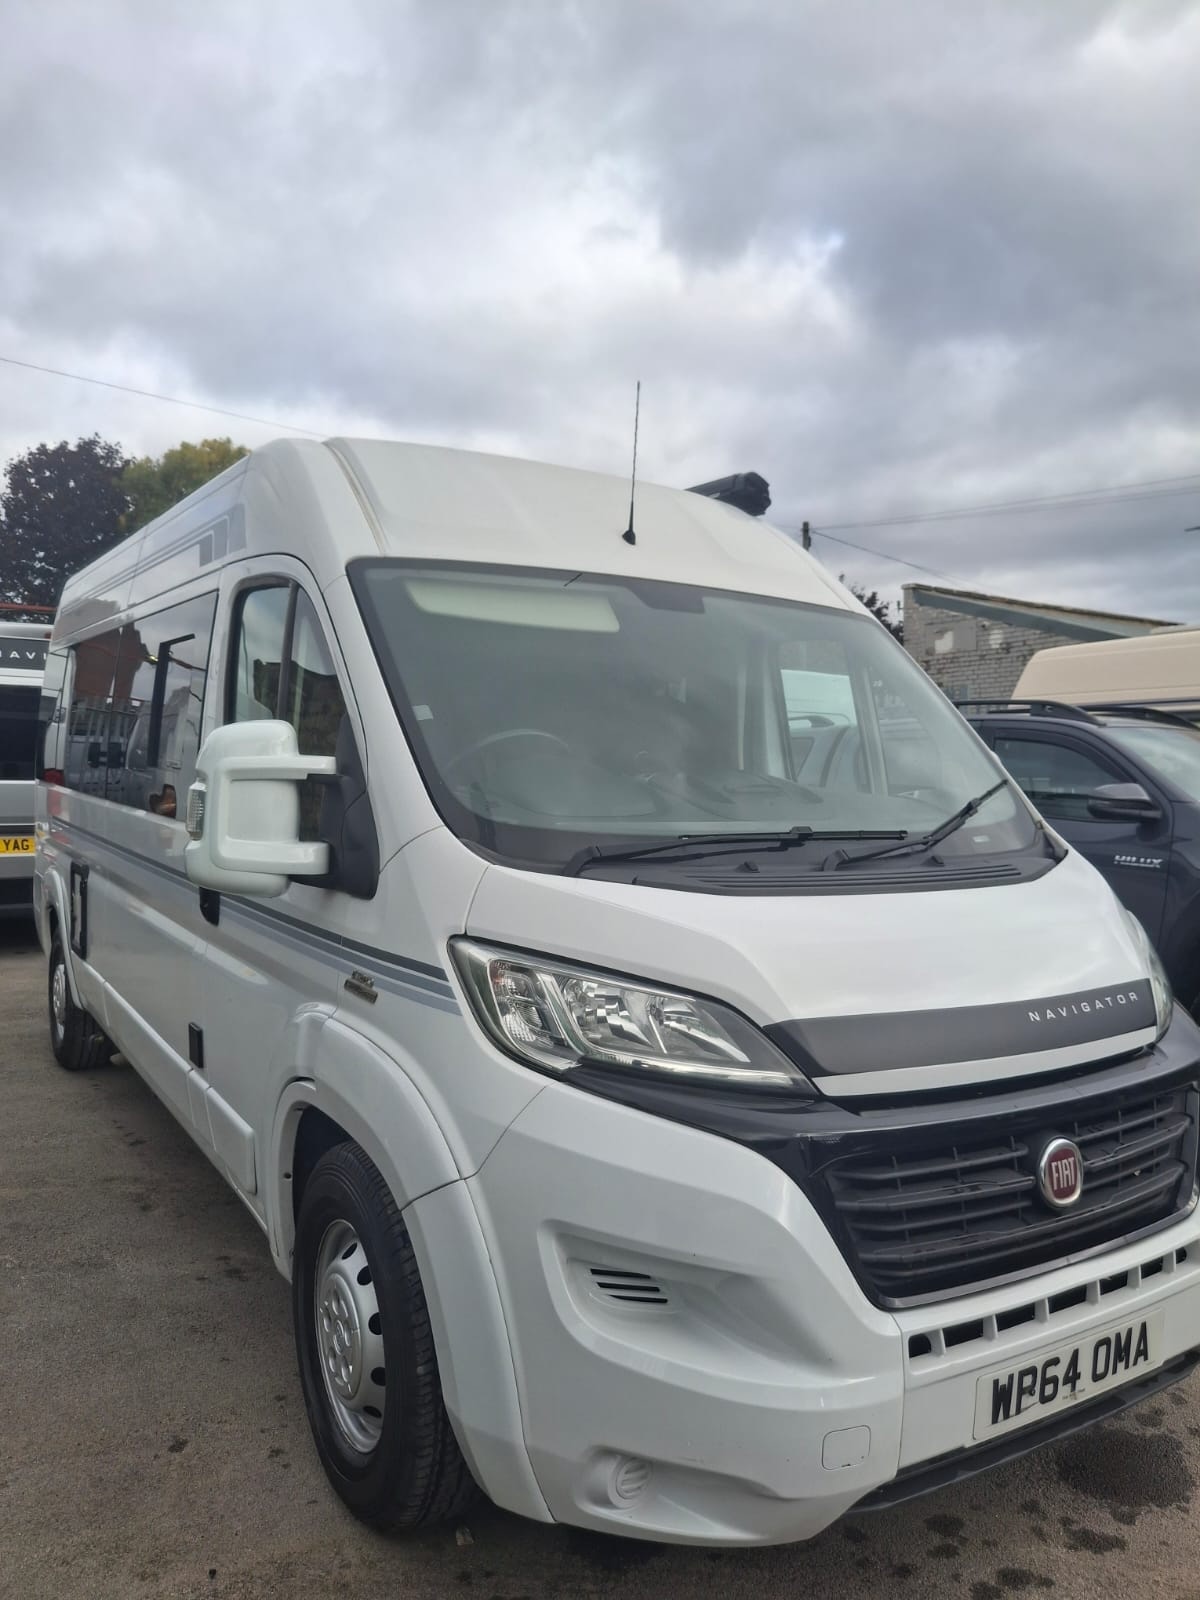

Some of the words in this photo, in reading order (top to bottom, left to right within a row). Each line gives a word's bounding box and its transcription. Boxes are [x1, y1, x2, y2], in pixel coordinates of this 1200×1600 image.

[0, 650, 47, 660] AVI
[3, 839, 30, 851] YAG
[1028, 991, 1138, 1022] NAVIGATOR
[1051, 1156, 1075, 1191] FIAT
[991, 1348, 1081, 1425] WP64
[1091, 1320, 1149, 1383] OMA
